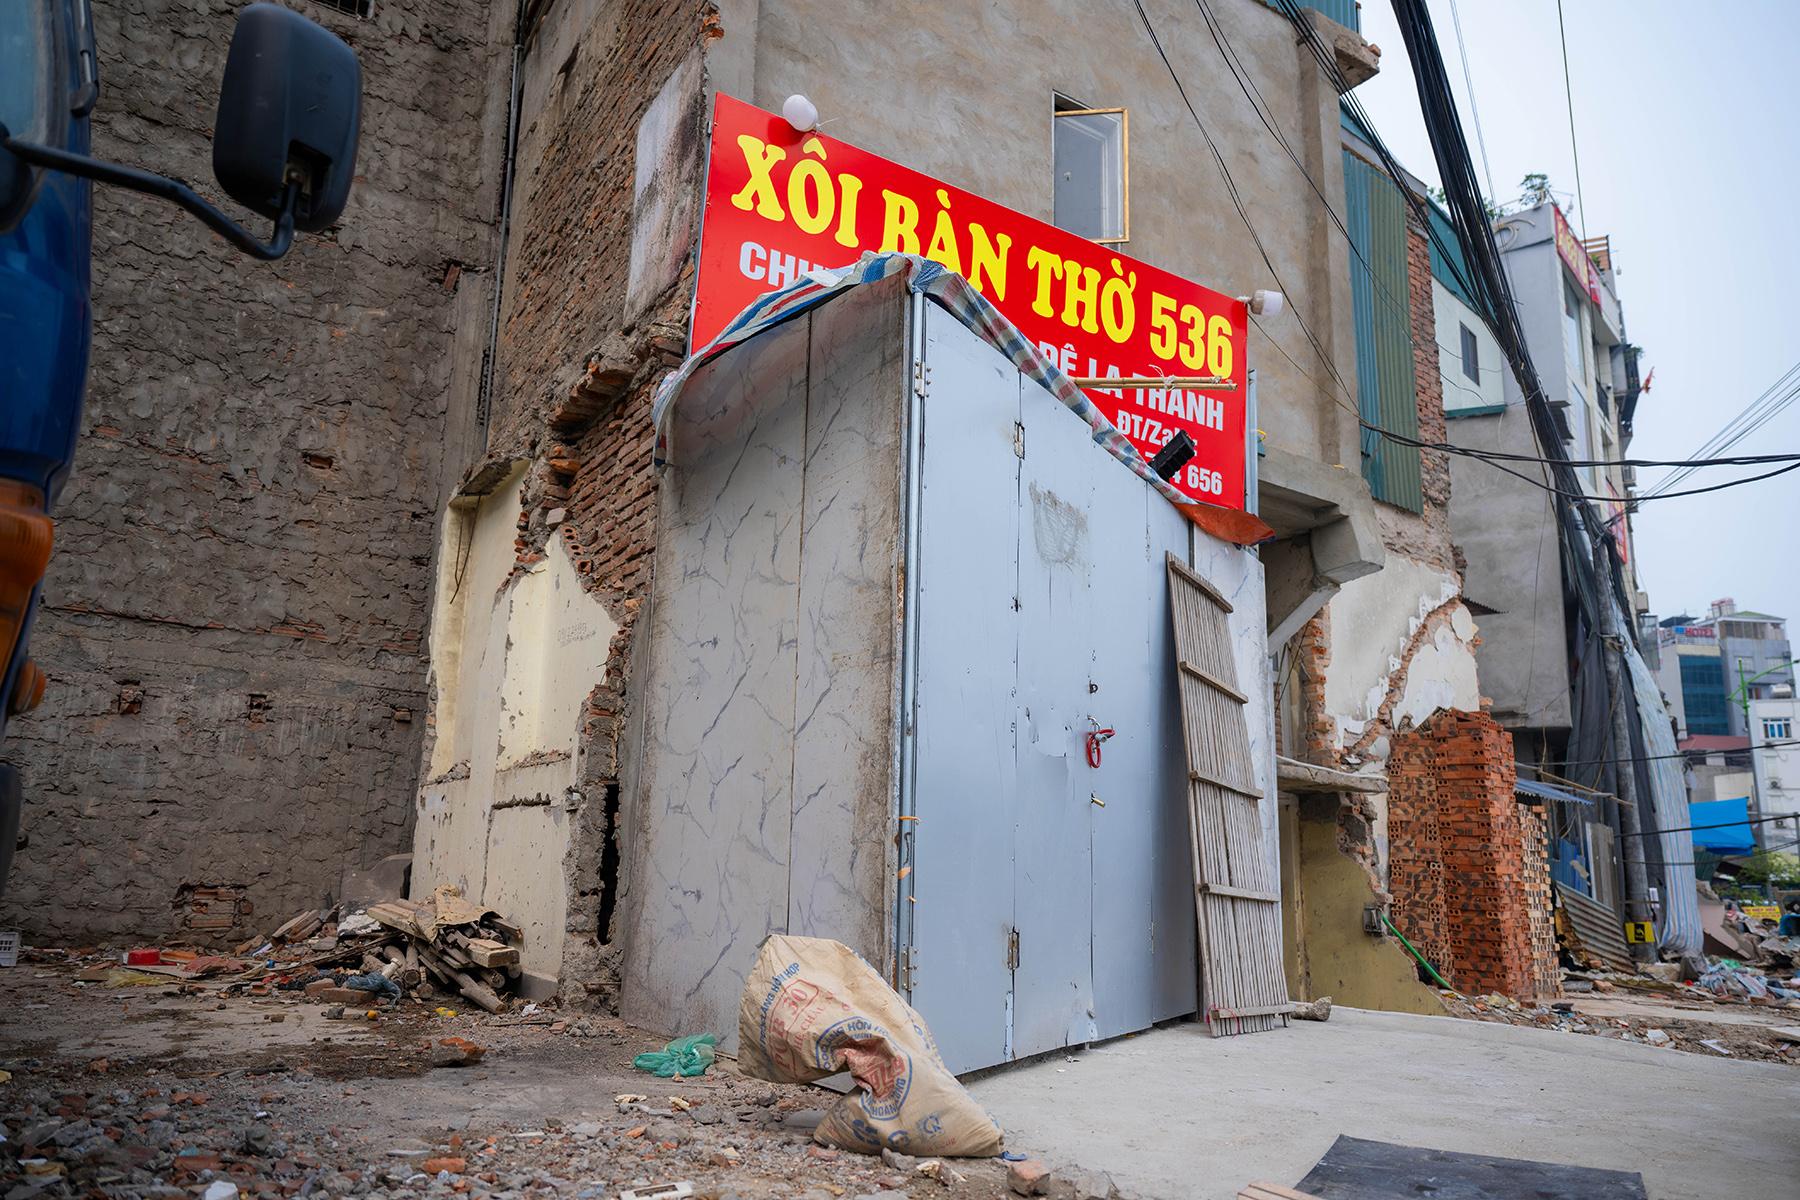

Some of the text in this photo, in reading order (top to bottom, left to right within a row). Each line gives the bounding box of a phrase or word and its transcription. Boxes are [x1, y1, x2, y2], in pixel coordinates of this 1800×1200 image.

[732, 135, 1233, 380] XÔI BÀN THỜ 536
[1187, 464, 1223, 496] 656
[1685, 626, 1717, 638] HOTEL
[782, 988, 808, 1016] 30
